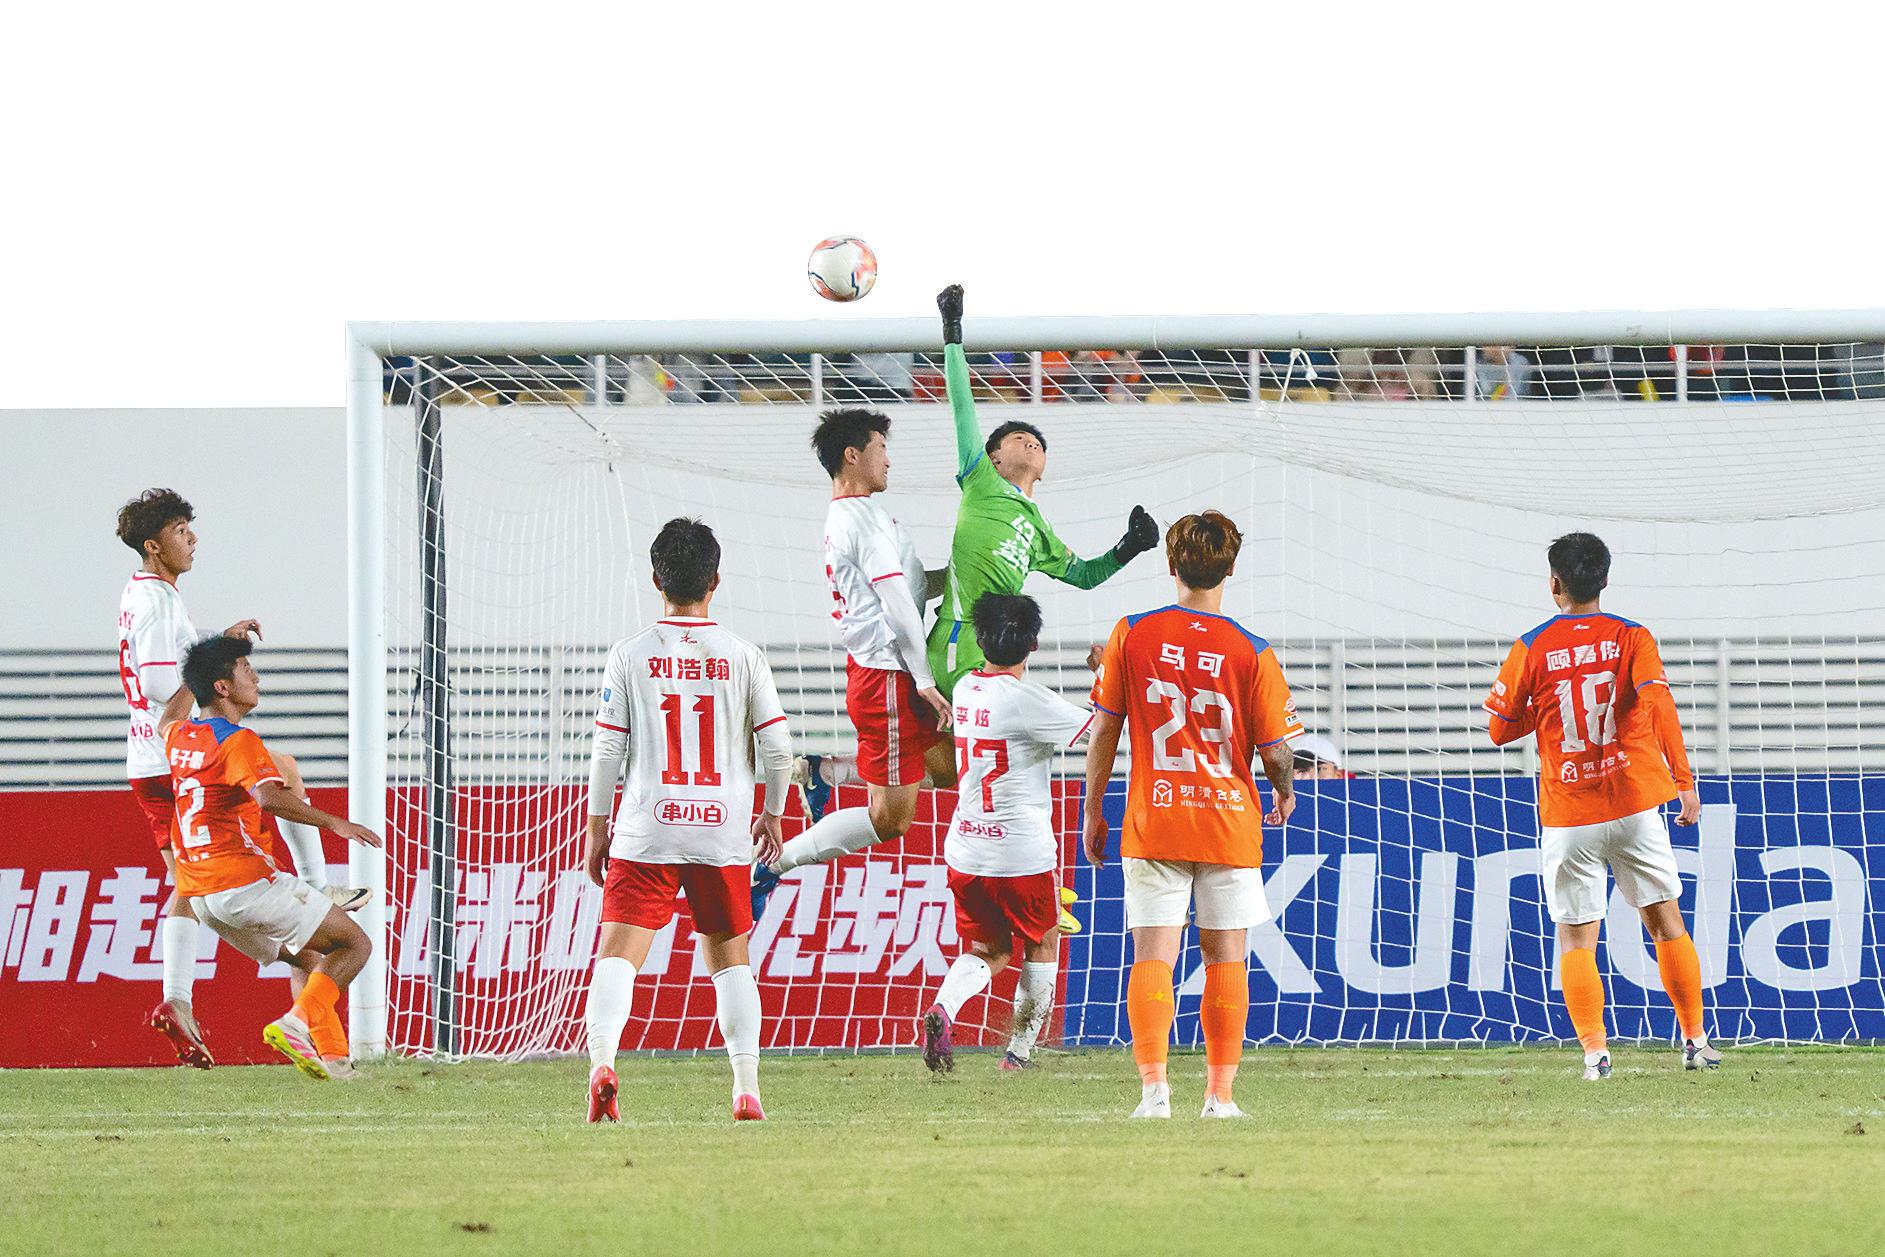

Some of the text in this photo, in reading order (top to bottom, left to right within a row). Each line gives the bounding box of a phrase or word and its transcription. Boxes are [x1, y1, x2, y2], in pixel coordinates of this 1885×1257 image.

[647, 656, 730, 681] 刘浩翰
[1159, 642, 1225, 678] 马可
[956, 706, 991, 728] 李炫
[1145, 677, 1234, 779] 23
[1554, 670, 1618, 753] 18
[659, 693, 721, 787] 11
[661, 802, 722, 823] 串小白
[958, 818, 1004, 839] 串小白
[1180, 803, 1867, 994] xunda
